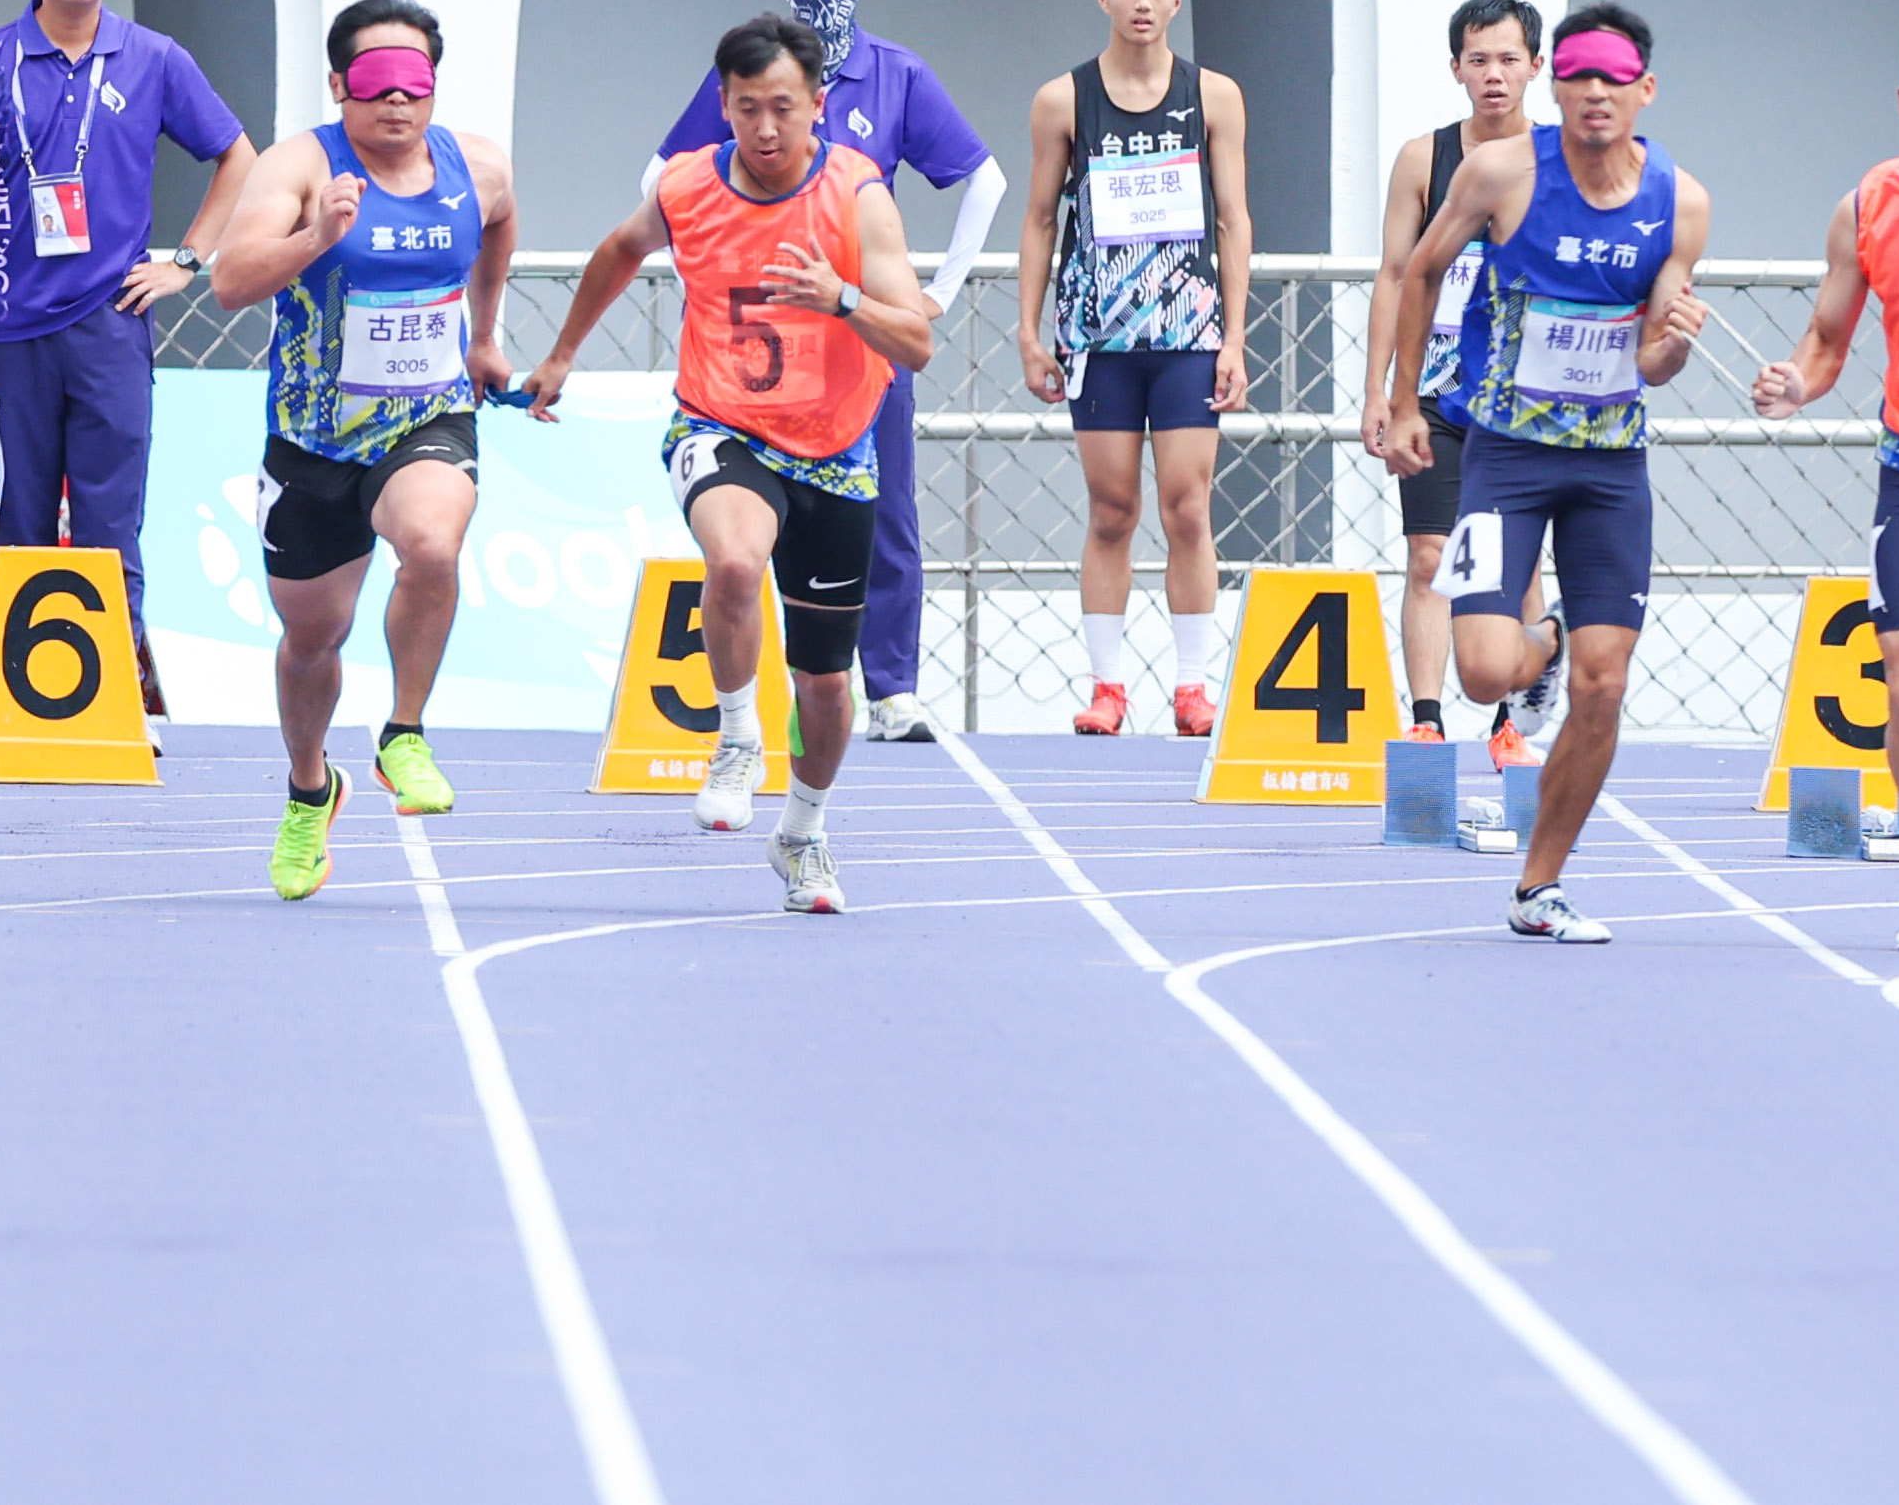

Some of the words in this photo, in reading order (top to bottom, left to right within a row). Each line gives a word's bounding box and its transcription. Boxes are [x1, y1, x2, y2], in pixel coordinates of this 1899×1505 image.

[1101, 130, 1183, 156] 台中市
[1108, 170, 1184, 199] 張宏恩
[1130, 209, 1167, 224] 3025
[371, 225, 452, 251] 臺北市
[1555, 236, 1639, 269] 臺北市
[368, 311, 447, 342] 古昆泰
[729, 286, 784, 392] 5
[1545, 322, 1633, 354] 楊川輝
[386, 359, 429, 374] 3005
[1562, 368, 1602, 383] 3011
[680, 442, 696, 482] 6
[1453, 526, 1475, 581] 4
[2, 569, 106, 720] 6
[1254, 592, 1365, 744] 4
[1814, 599, 1890, 750] 3
